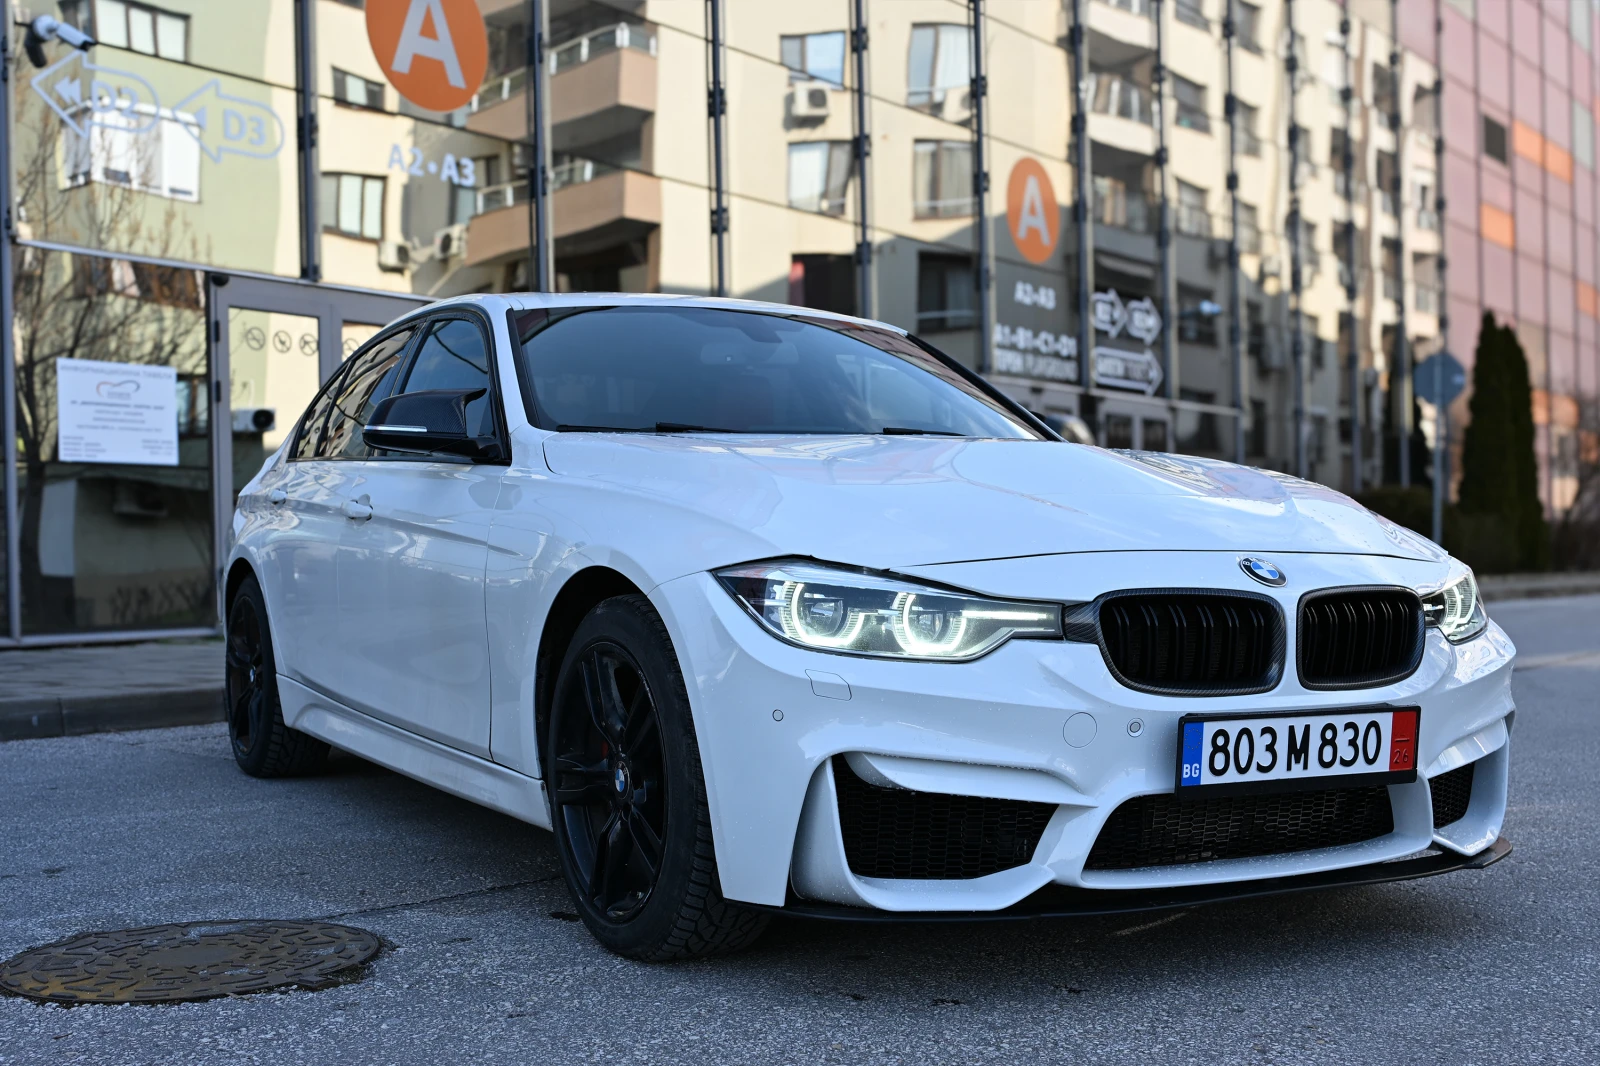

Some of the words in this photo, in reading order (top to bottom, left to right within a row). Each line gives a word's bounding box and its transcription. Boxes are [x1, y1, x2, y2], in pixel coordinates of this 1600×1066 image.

[391, 0, 467, 89] A
[91, 80, 139, 120] D2
[223, 108, 267, 146] D3
[1017, 174, 1051, 247] A
[1182, 763, 1200, 779] BG
[1208, 726, 1278, 777] 803
[1286, 723, 1311, 772] M
[1317, 720, 1382, 769] 830
[1393, 748, 1410, 764] 26
